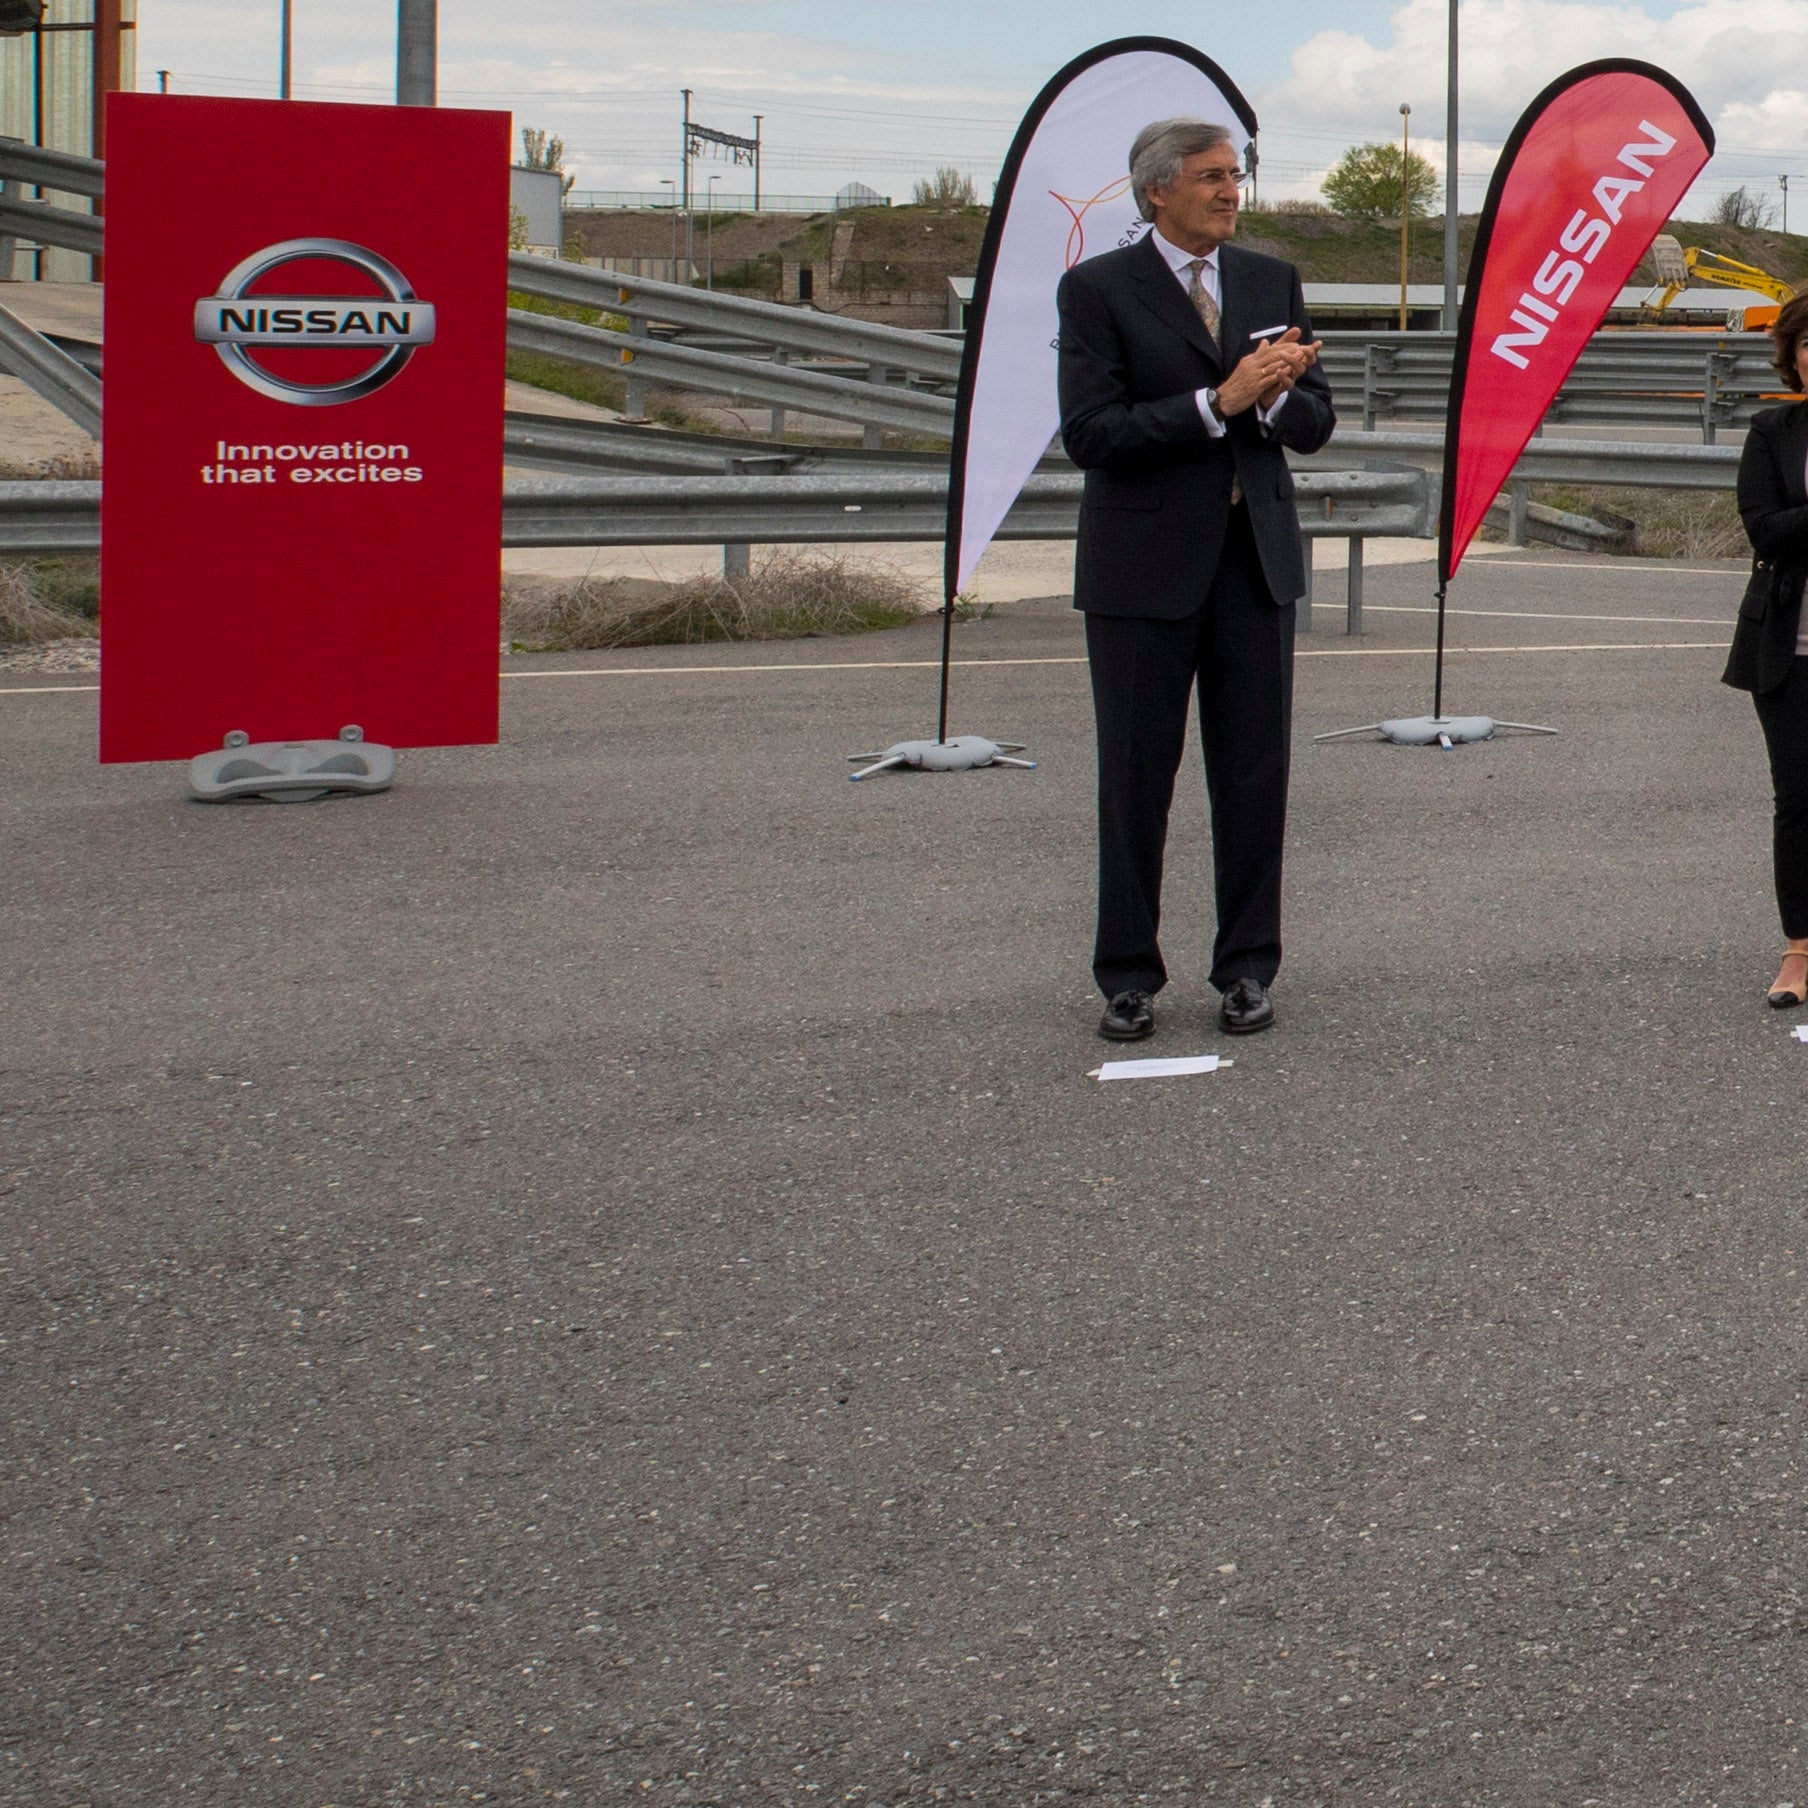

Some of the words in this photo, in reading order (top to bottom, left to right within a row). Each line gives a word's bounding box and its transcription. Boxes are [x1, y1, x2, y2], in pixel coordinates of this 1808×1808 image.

[1117, 216, 1146, 248] SAN
[1490, 119, 1678, 370] NISSAN
[219, 308, 412, 335] NISSAN
[216, 441, 409, 461] Innovation
[201, 464, 277, 483] that
[290, 464, 423, 482] excites
